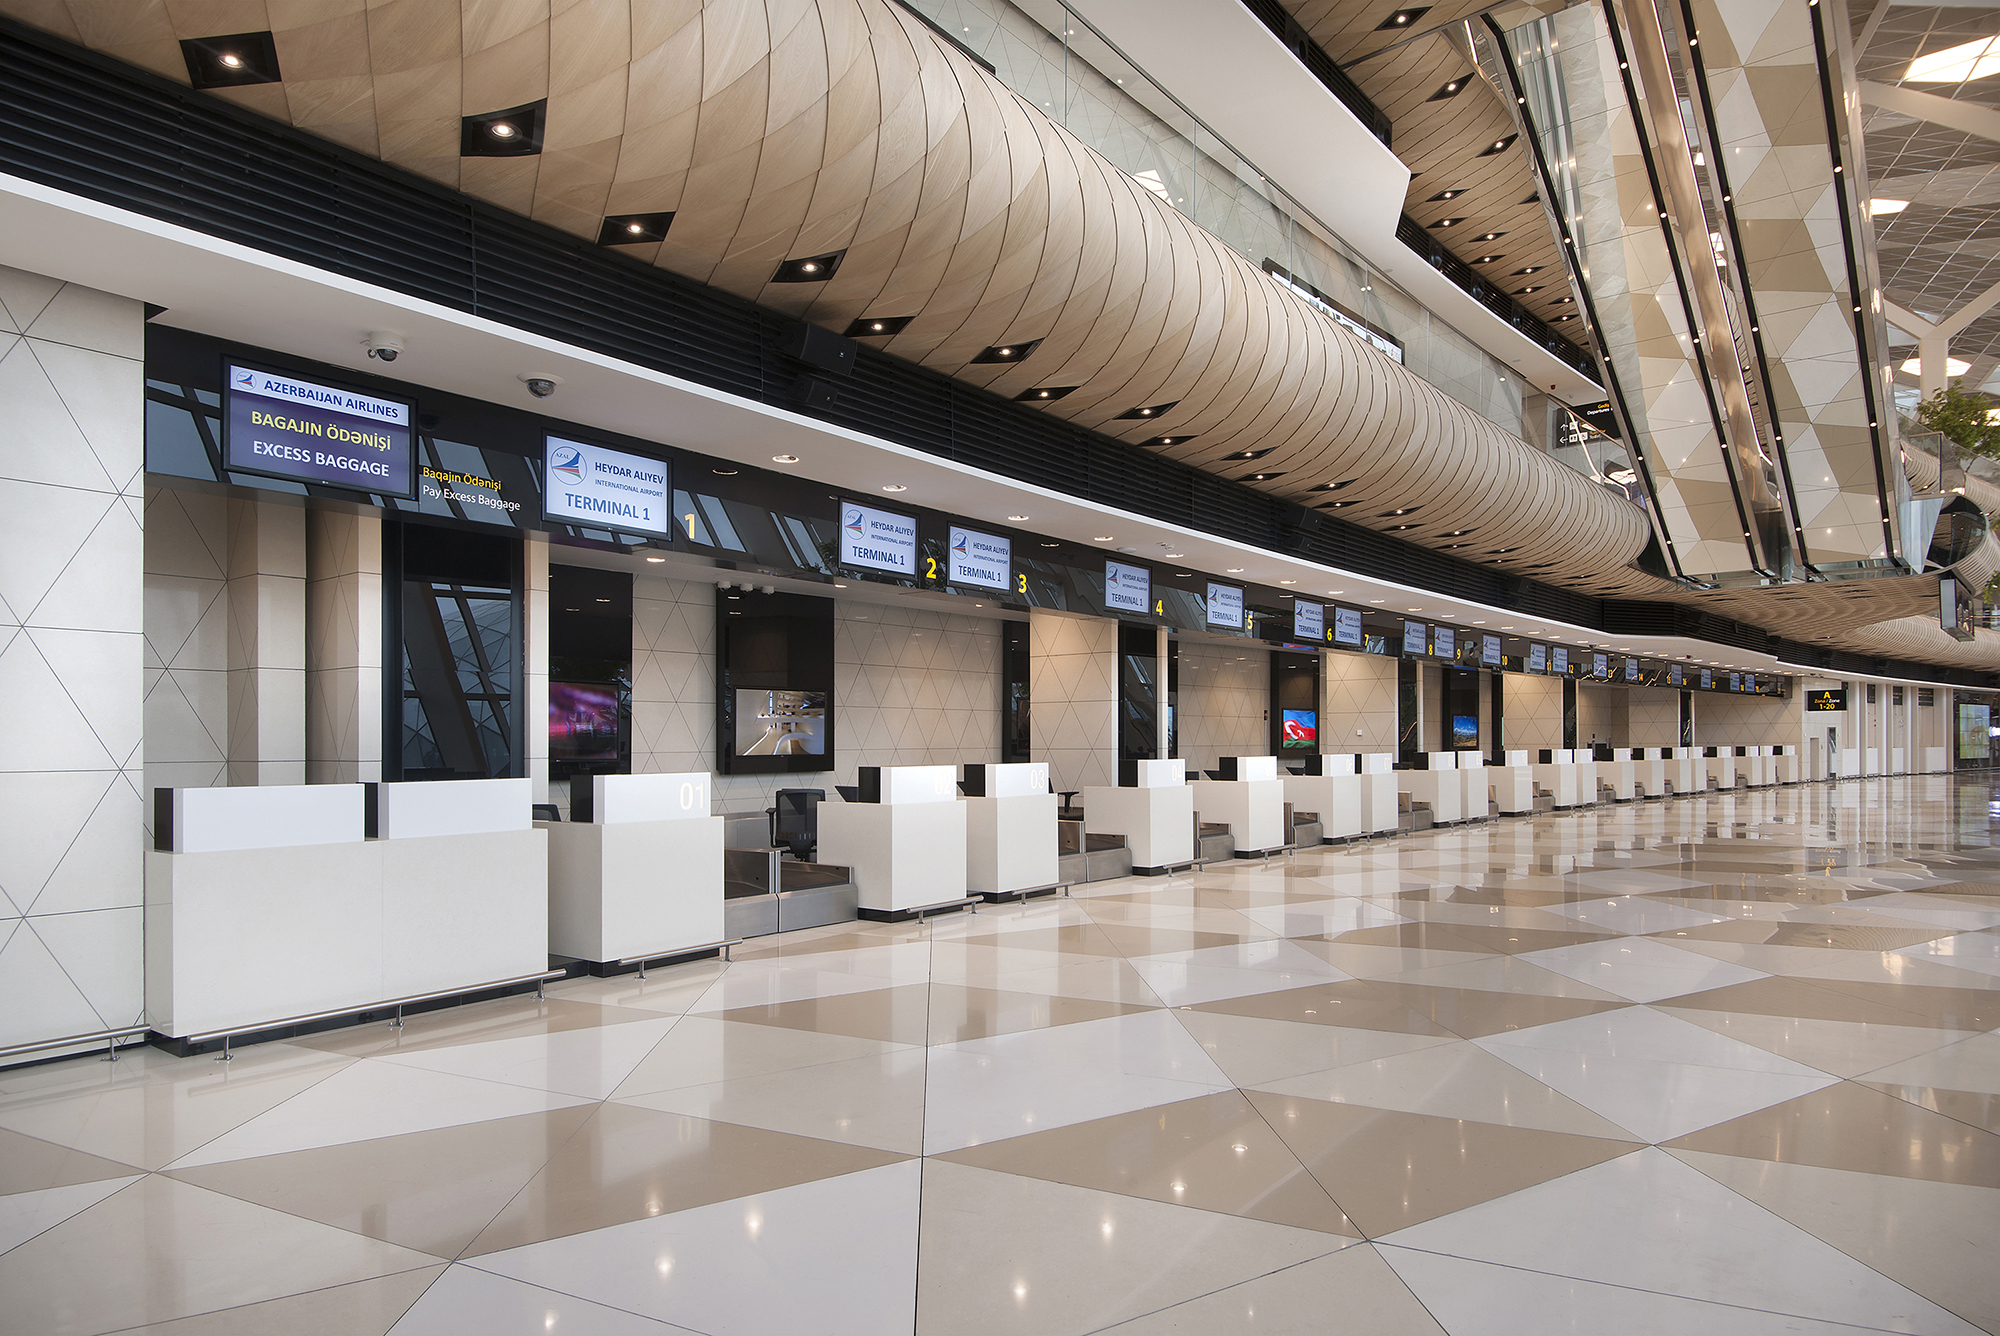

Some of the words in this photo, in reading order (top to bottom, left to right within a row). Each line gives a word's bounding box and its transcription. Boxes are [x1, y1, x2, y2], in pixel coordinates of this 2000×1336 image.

[264, 380, 342, 407] AZERBAIJAN
[345, 398, 399, 418] AIRLINES
[251, 411, 322, 437] BAGAJIN
[326, 423, 391, 452] ÖDƏNİŞİ
[253, 441, 311, 463] EXCESS
[315, 451, 390, 477] BAGGAGE
[422, 467, 461, 483] Baqajın
[463, 473, 502, 491] Ödənişi
[595, 462, 632, 478] HEYDAR
[633, 470, 664, 484] ALIYEV
[595, 479, 639, 493] INTERNATIONAL
[639, 488, 663, 498] AIRPORT
[422, 485, 441, 499] Pay
[443, 488, 476, 503] Excess
[478, 494, 521, 512] Baggage
[565, 492, 639, 519] TERMINAL
[642, 507, 650, 521] 1
[684, 513, 695, 539] 1
[871, 520, 894, 533] HEYDAR
[894, 526, 914, 536] ALIYEV
[871, 534, 899, 545] INTERNATIONAL
[973, 542, 992, 552] HEYDAR
[993, 546, 1009, 555] ALIYEV
[852, 546, 898, 565] TERMINAL
[900, 555, 905, 566] 1
[926, 557, 937, 579] 2
[958, 565, 996, 582] TERMINAL
[997, 572, 1001, 582] 1
[1018, 574, 1027, 593] 3
[1111, 592, 1139, 606] TERMINAL
[1140, 598, 1143, 607] 1
[1156, 600, 1163, 616] 4
[1212, 611, 1234, 622] TERMINAL
[1247, 614, 1253, 630] 5
[1298, 624, 1316, 635] TERMINAL
[1327, 628, 1333, 641] 6
[1364, 634, 1369, 646] 7
[1428, 644, 1433, 656] 8
[1456, 648, 1461, 659] 9
[1823, 691, 1831, 699] A
[1031, 768, 1046, 789] 03
[1171, 764, 1183, 781] 04
[935, 772, 954, 795] 02
[680, 781, 705, 810] 01
